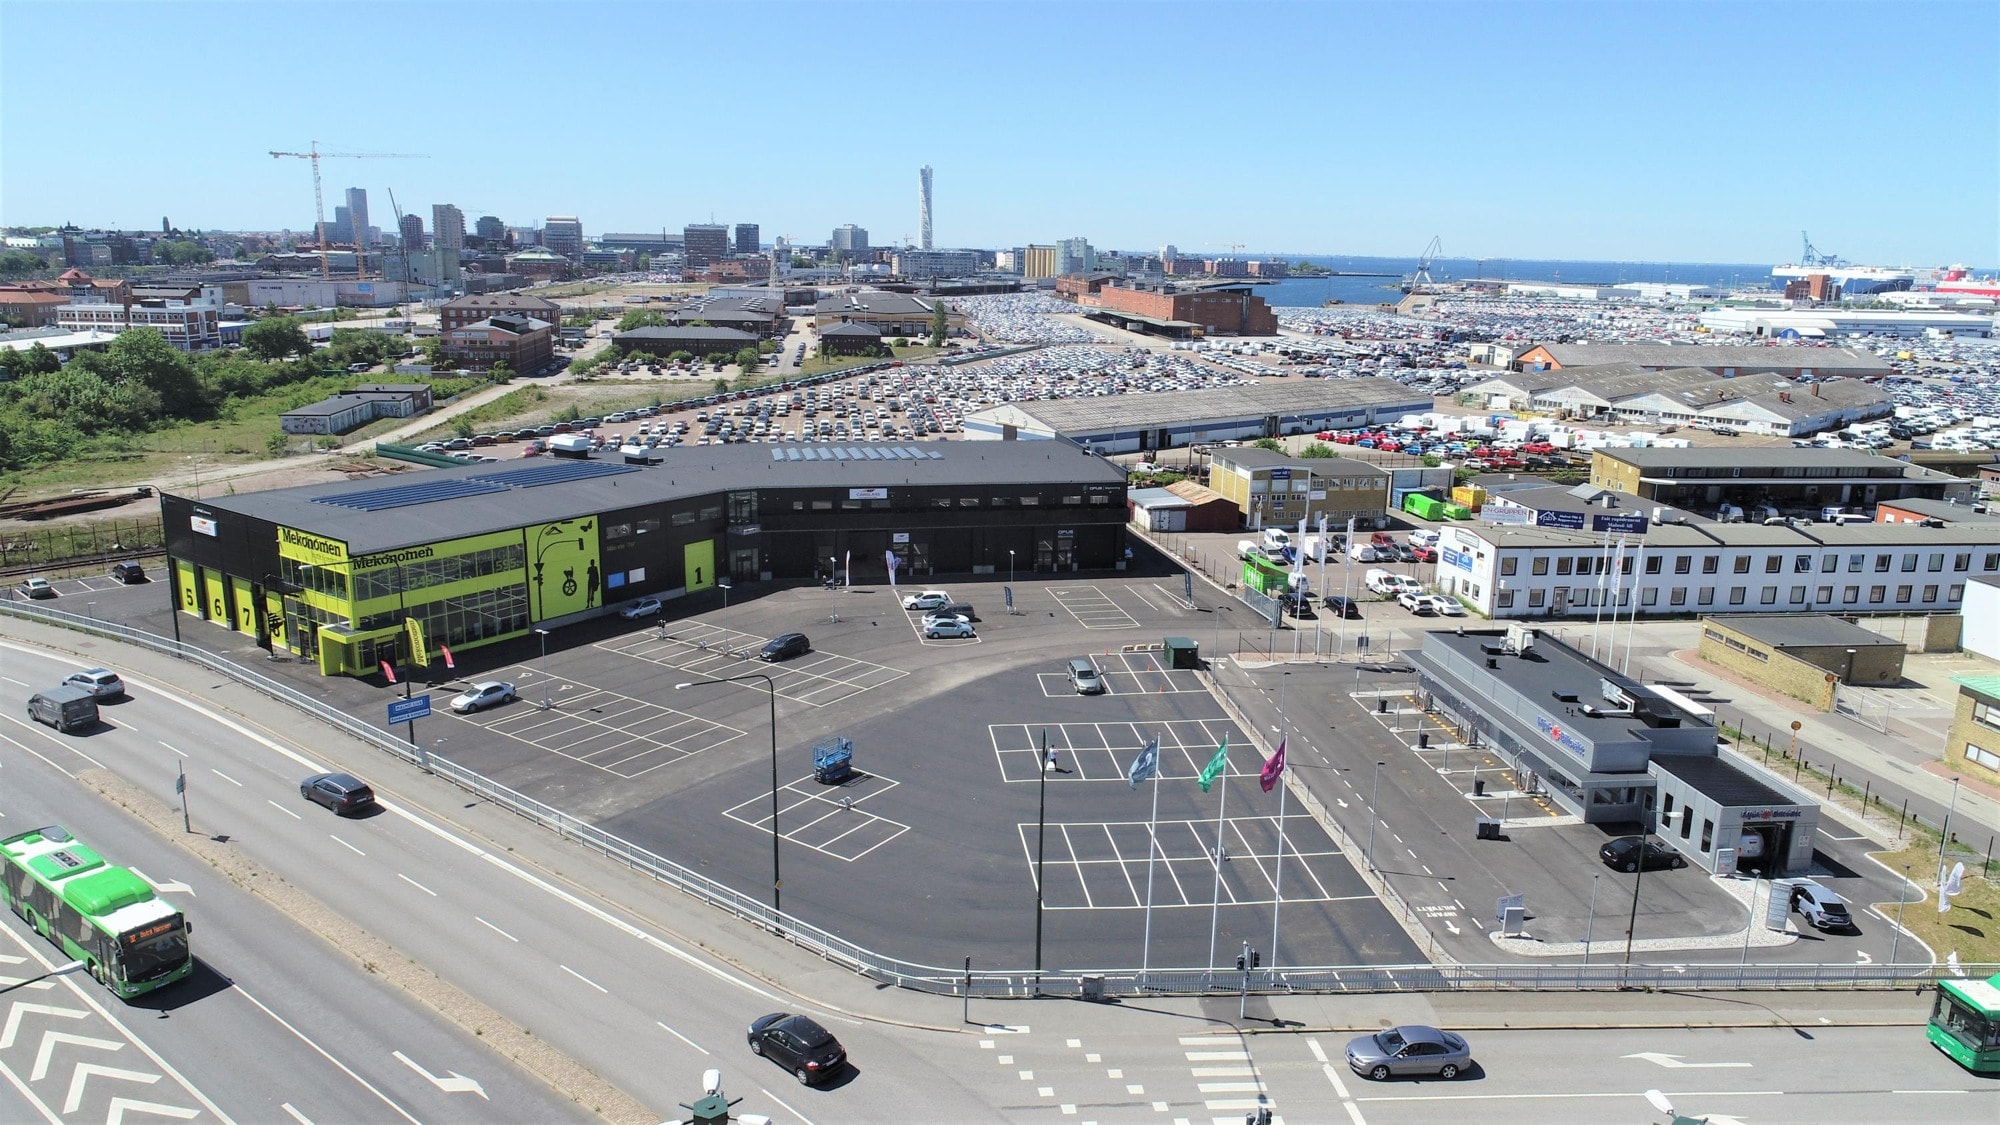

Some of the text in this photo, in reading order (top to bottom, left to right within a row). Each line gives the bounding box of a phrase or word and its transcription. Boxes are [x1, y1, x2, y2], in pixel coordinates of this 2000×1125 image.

[282, 528, 342, 557] Mekonomen
[353, 547, 434, 571] Mekonomen
[695, 567, 703, 585] 1
[186, 588, 193, 606] 5
[214, 598, 222, 616] 6
[243, 608, 250, 626] 7
